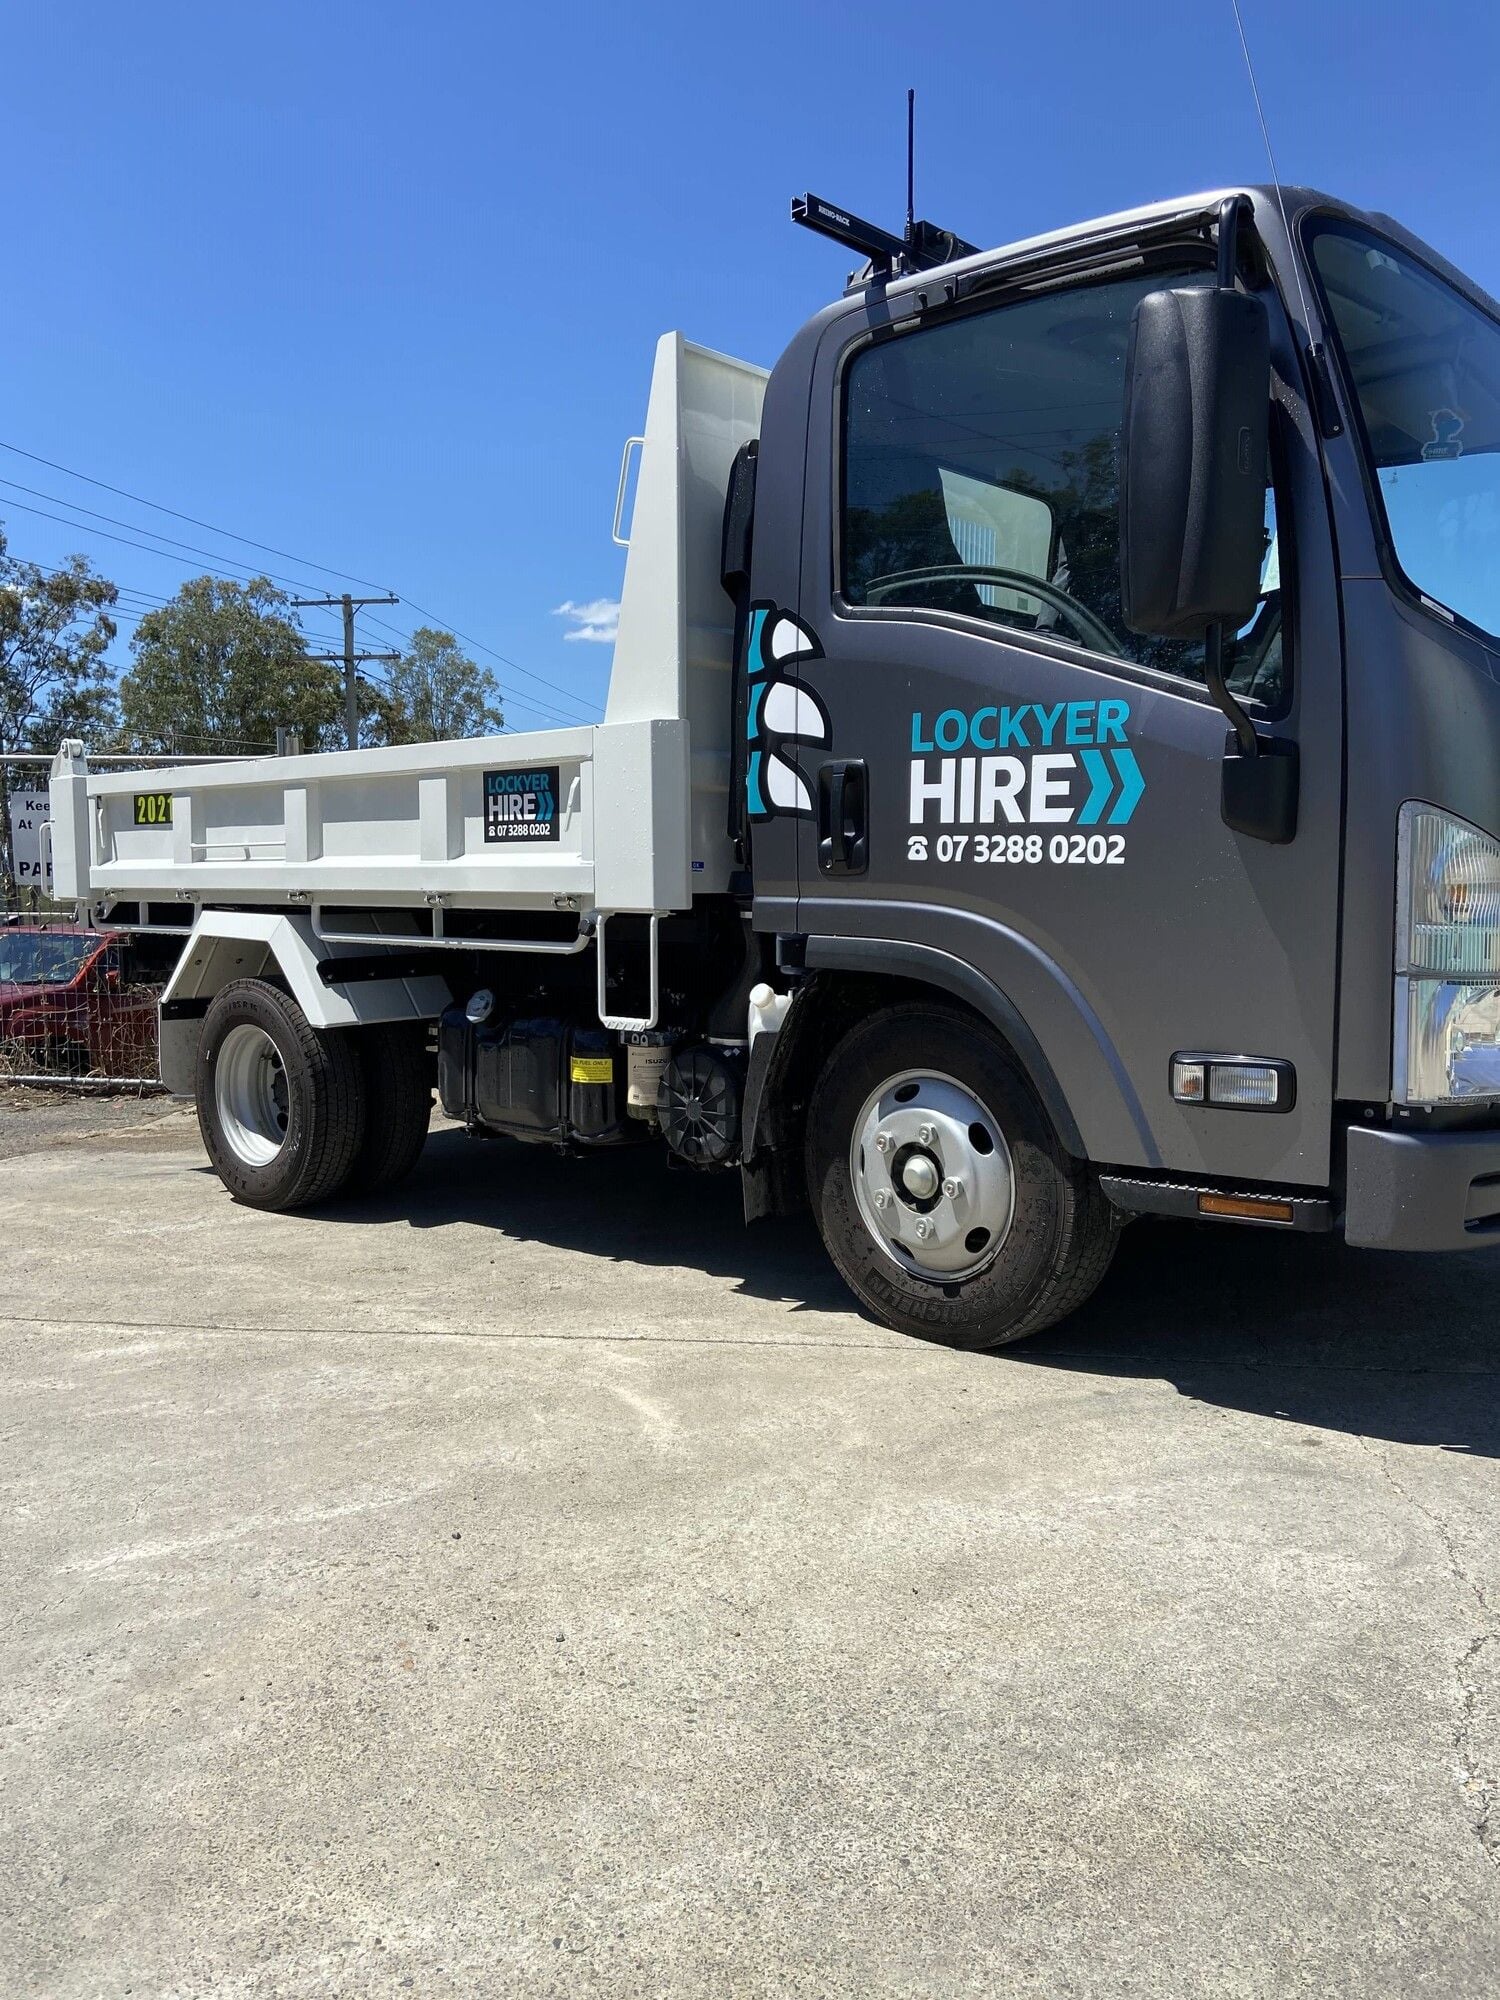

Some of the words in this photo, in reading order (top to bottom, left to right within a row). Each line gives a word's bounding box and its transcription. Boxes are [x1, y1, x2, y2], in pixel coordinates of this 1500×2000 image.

[911, 699, 1130, 752] LOCKYER
[488, 774, 549, 793] LOCKYER
[909, 753, 1077, 824] HIRE
[488, 793, 537, 822] HIRE
[18, 819, 33, 830] At
[497, 825, 507, 836] 07
[508, 824, 528, 836] 3288
[529, 823, 551, 836] 0202
[936, 834, 969, 862] 07
[974, 834, 1043, 864] 3288
[1049, 834, 1125, 865] 0202
